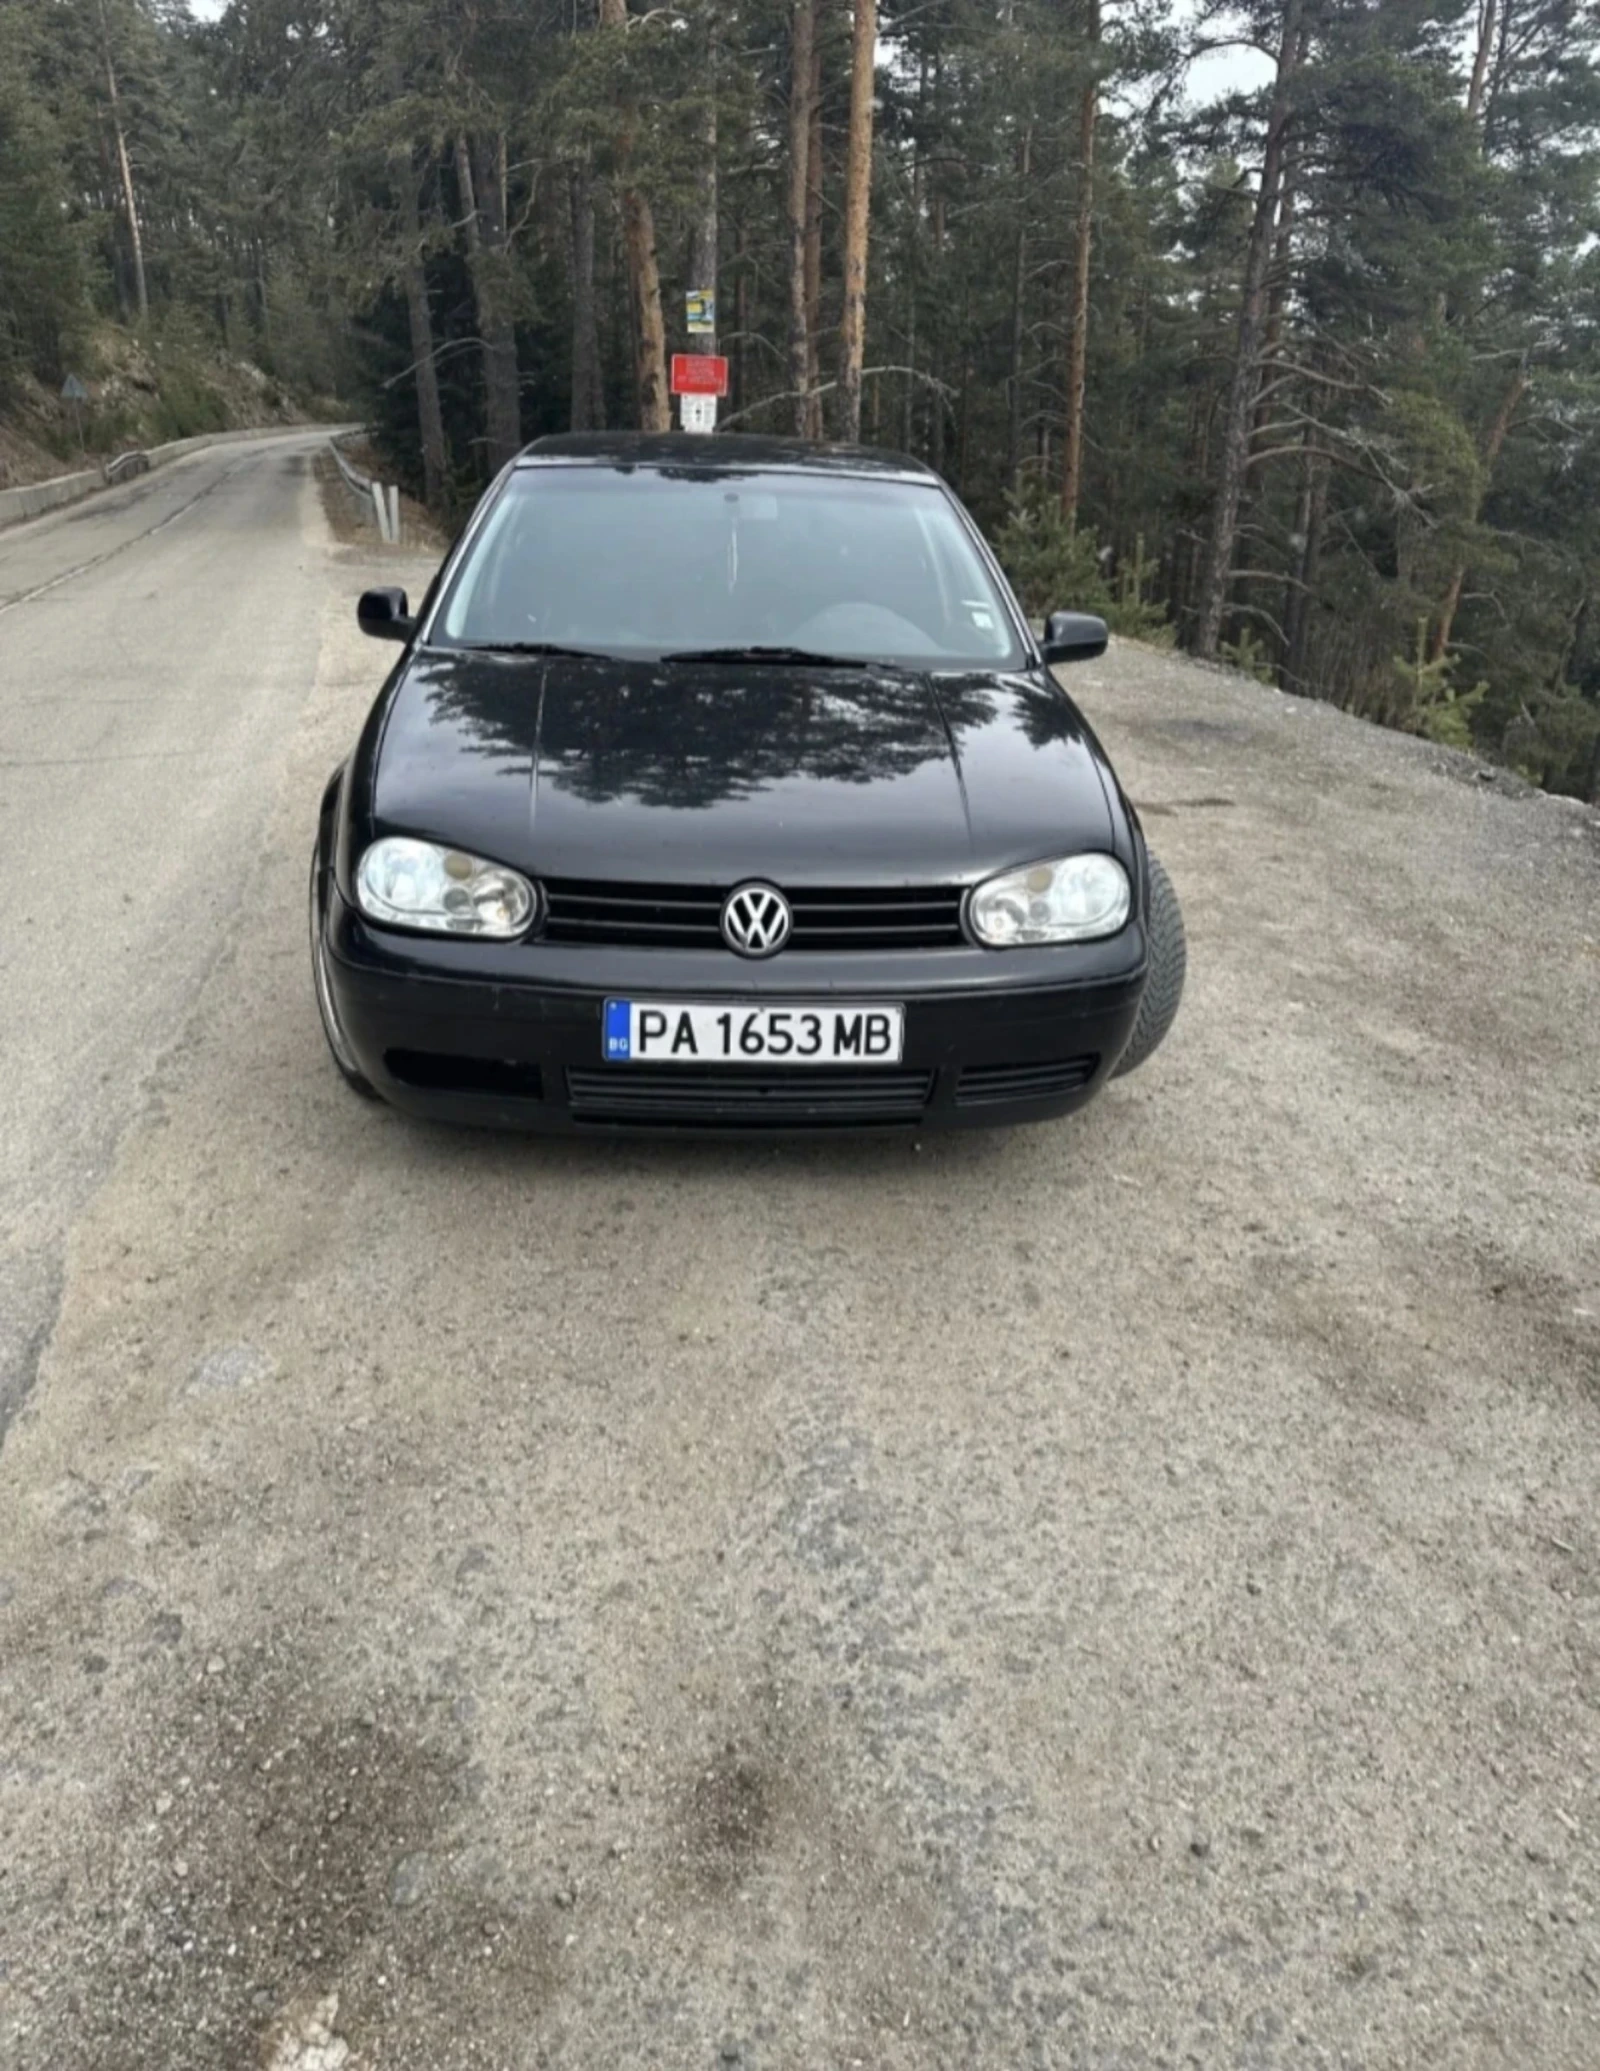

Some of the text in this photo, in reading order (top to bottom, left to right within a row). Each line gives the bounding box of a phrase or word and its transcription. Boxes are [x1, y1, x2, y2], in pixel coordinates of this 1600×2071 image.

[726, 888, 788, 953] VW
[608, 1038, 629, 1051] BG
[639, 1010, 892, 1056] PA 1653 MB
